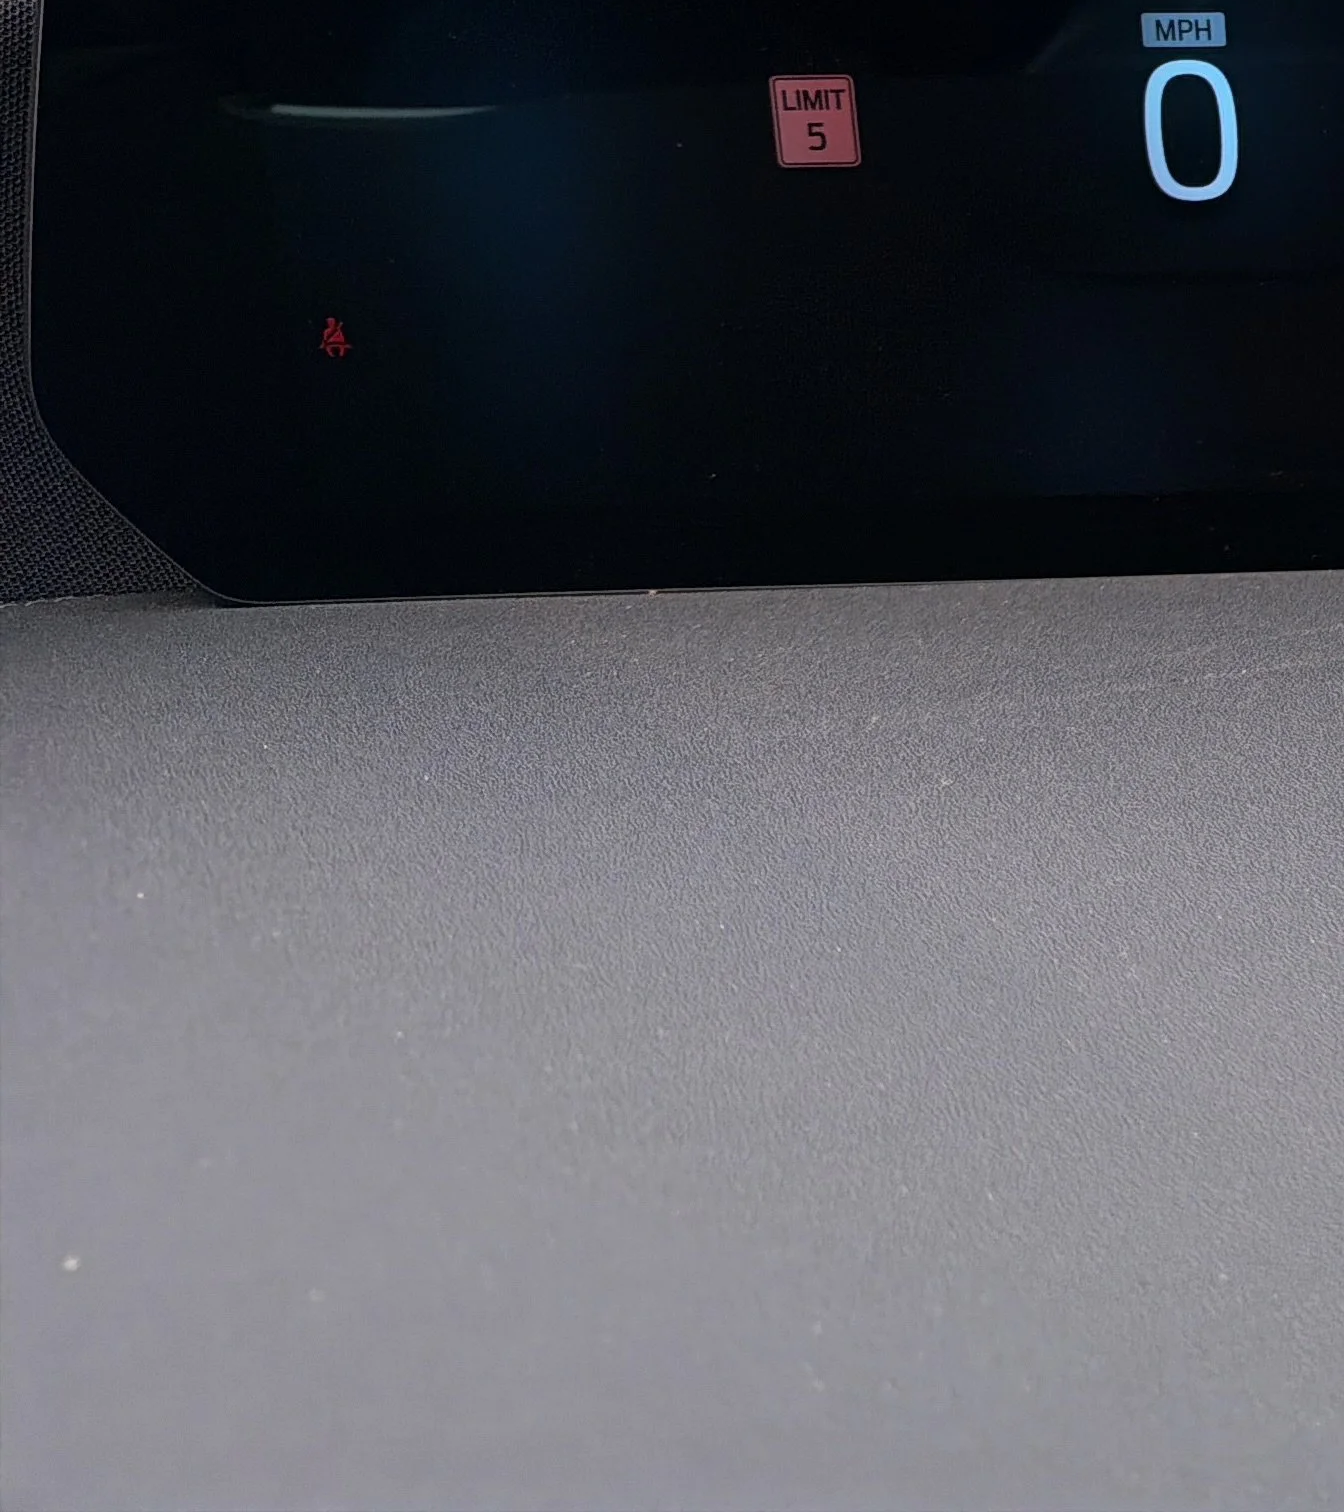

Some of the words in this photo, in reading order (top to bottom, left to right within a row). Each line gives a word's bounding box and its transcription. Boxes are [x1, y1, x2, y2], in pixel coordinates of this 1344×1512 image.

[1154, 19, 1213, 43] MPH
[781, 88, 846, 112] LIMIT
[806, 122, 828, 151] 5
[1144, 59, 1239, 202] 0
